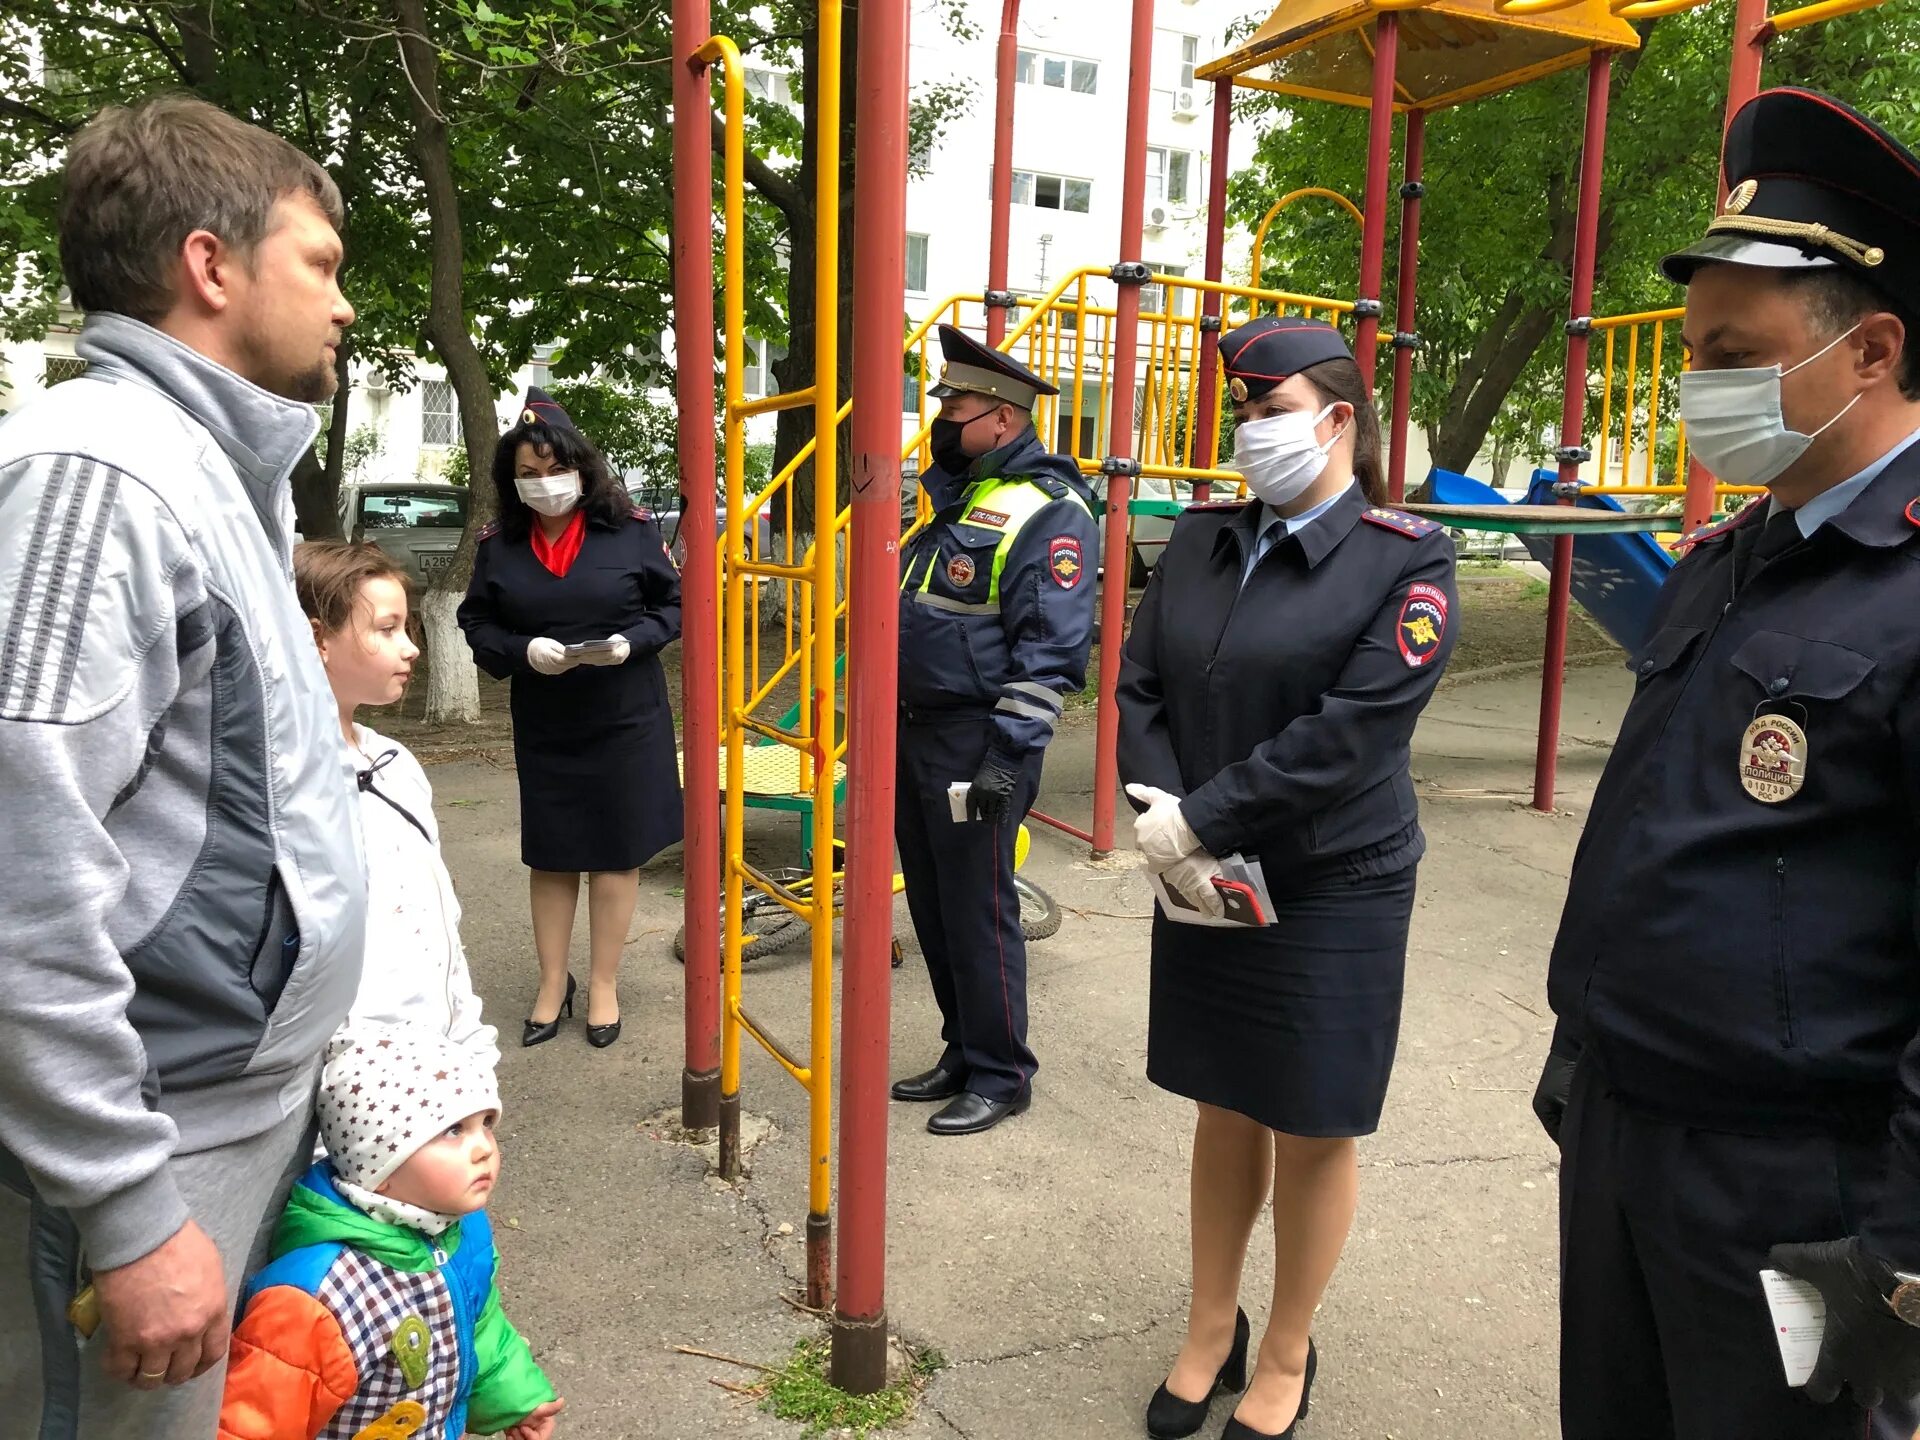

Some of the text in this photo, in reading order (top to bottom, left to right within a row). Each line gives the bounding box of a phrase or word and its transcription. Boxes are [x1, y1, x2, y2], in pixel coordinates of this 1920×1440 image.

[1052, 538, 1077, 546] ПОЛИЦИЯ
[1054, 549, 1078, 560] РОССИЯ
[1413, 585, 1448, 608] ПОЛИЦИЯ
[1409, 601, 1443, 625] РОССИЯ
[1405, 651, 1423, 666] МВД
[1748, 719, 1801, 745] МВД РОССИИ
[1745, 766, 1791, 785] ПОЛИЦИЯ
[1747, 780, 1785, 796] 010738
[1757, 791, 1773, 801] РОС
